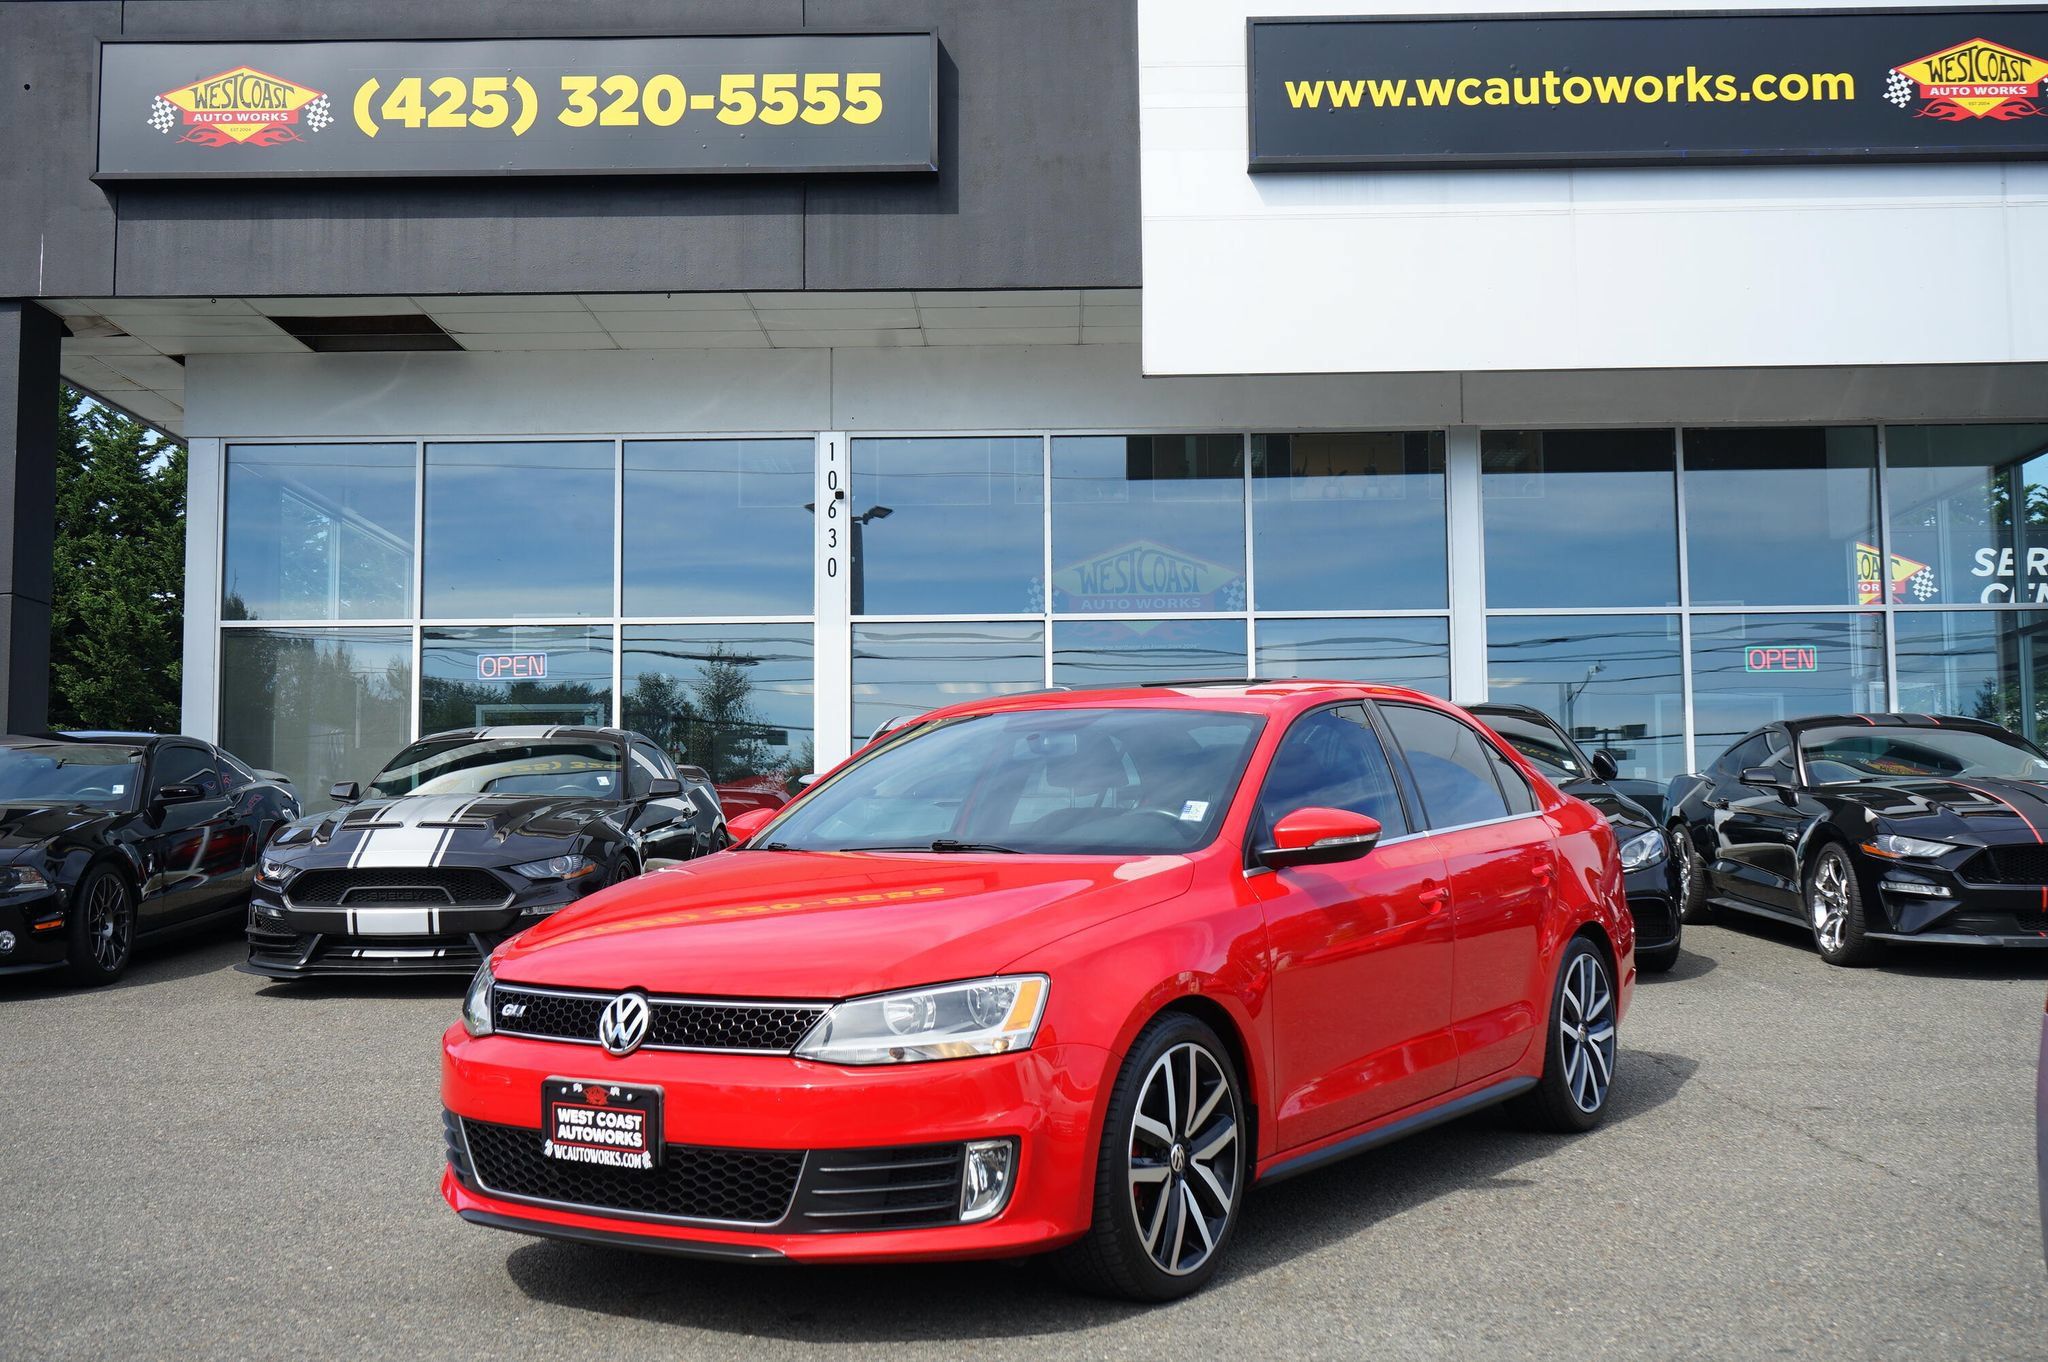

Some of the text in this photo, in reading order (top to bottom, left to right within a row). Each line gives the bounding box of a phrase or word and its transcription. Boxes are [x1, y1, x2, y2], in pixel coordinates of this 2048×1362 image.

[1286, 67, 1855, 108] www.wcautoworks.com
[1930, 86, 2028, 96] AUTO WORKS
[354, 73, 882, 136] (425) 320-5555
[193, 112, 289, 122] AUTO WORKS
[1081, 597, 1202, 610] AUTO WORKS
[480, 655, 544, 677] OPEN
[1749, 649, 1814, 670] OPEN
[557, 1107, 642, 1131] WEST COAST
[557, 1124, 643, 1148] AUTOWORKS
[553, 1144, 642, 1169] WCAUTOWORKS.COM
